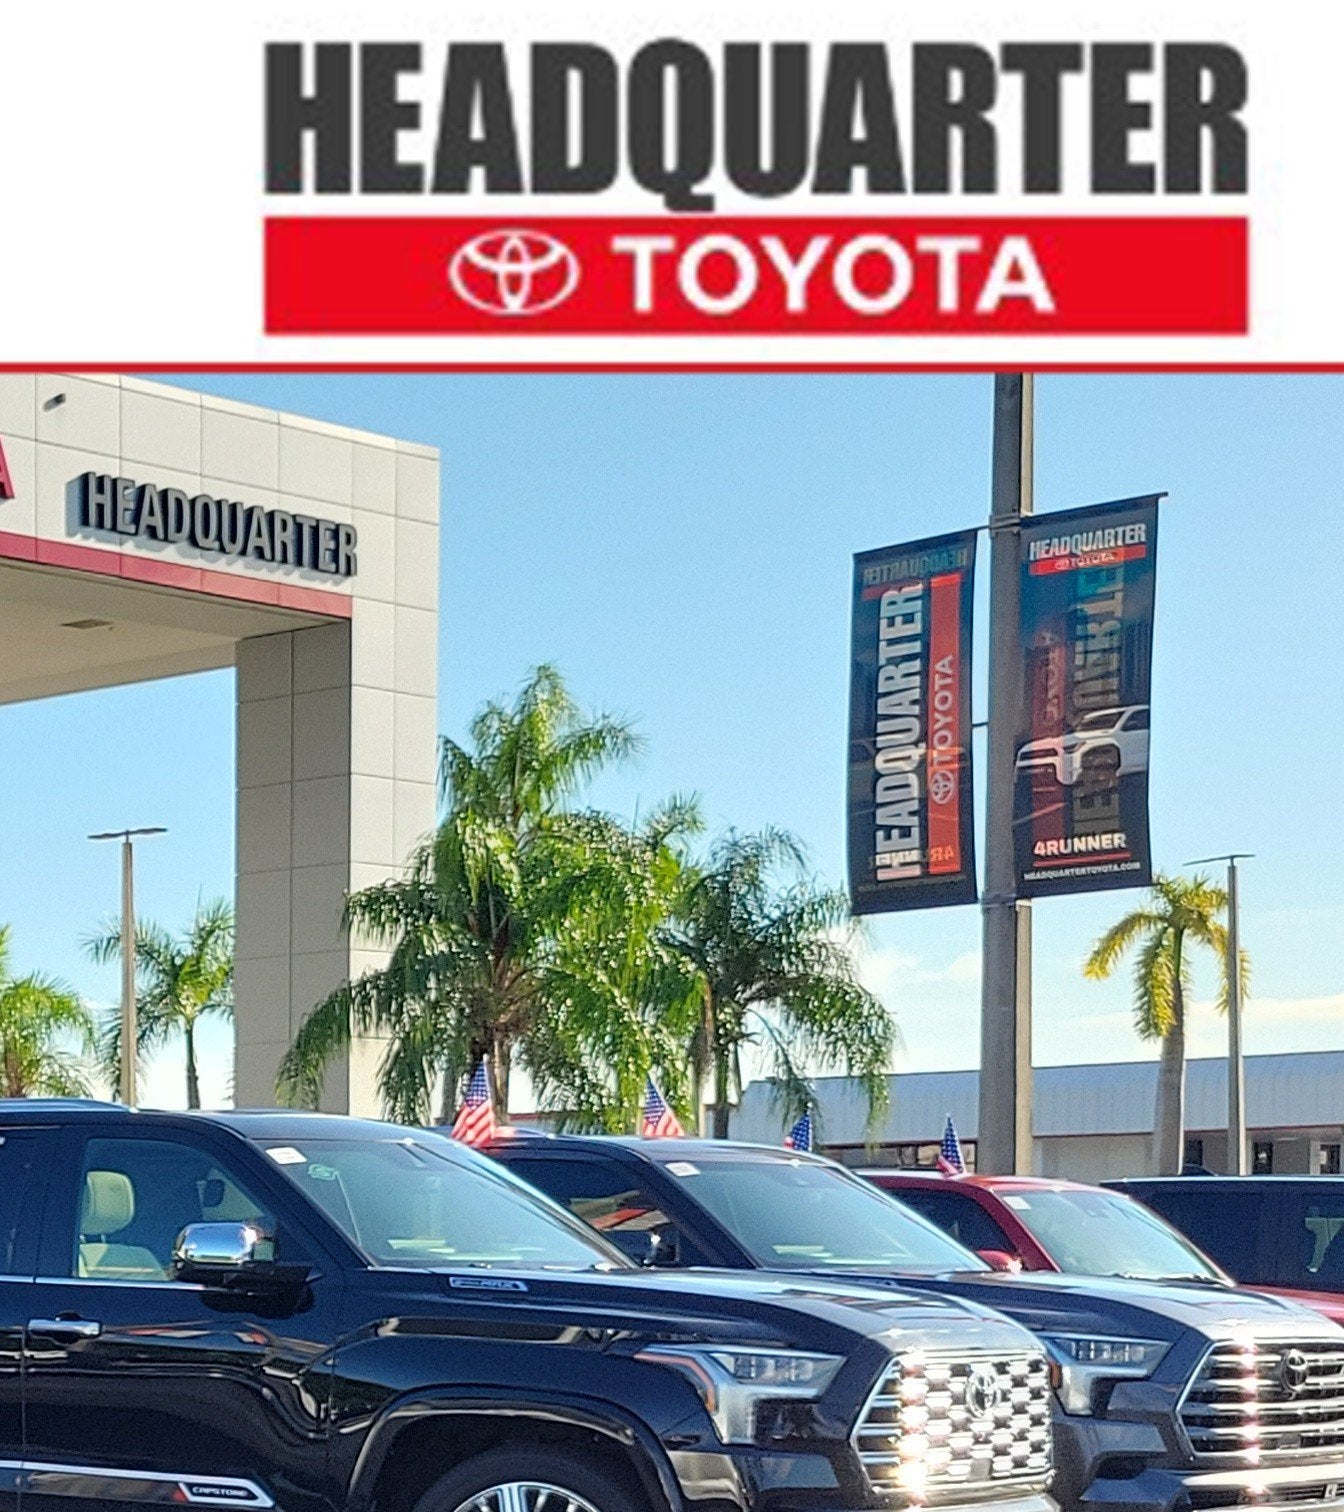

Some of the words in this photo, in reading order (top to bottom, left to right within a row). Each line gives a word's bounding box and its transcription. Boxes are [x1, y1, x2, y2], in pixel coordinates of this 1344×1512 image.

[79, 471, 358, 577] HEADQUARTER
[1029, 522, 1147, 561] HEADQUARTER
[875, 581, 926, 881] HEADQUARTER
[932, 653, 955, 770] TOYOTA
[1033, 832, 1127, 857] 4RUNNER
